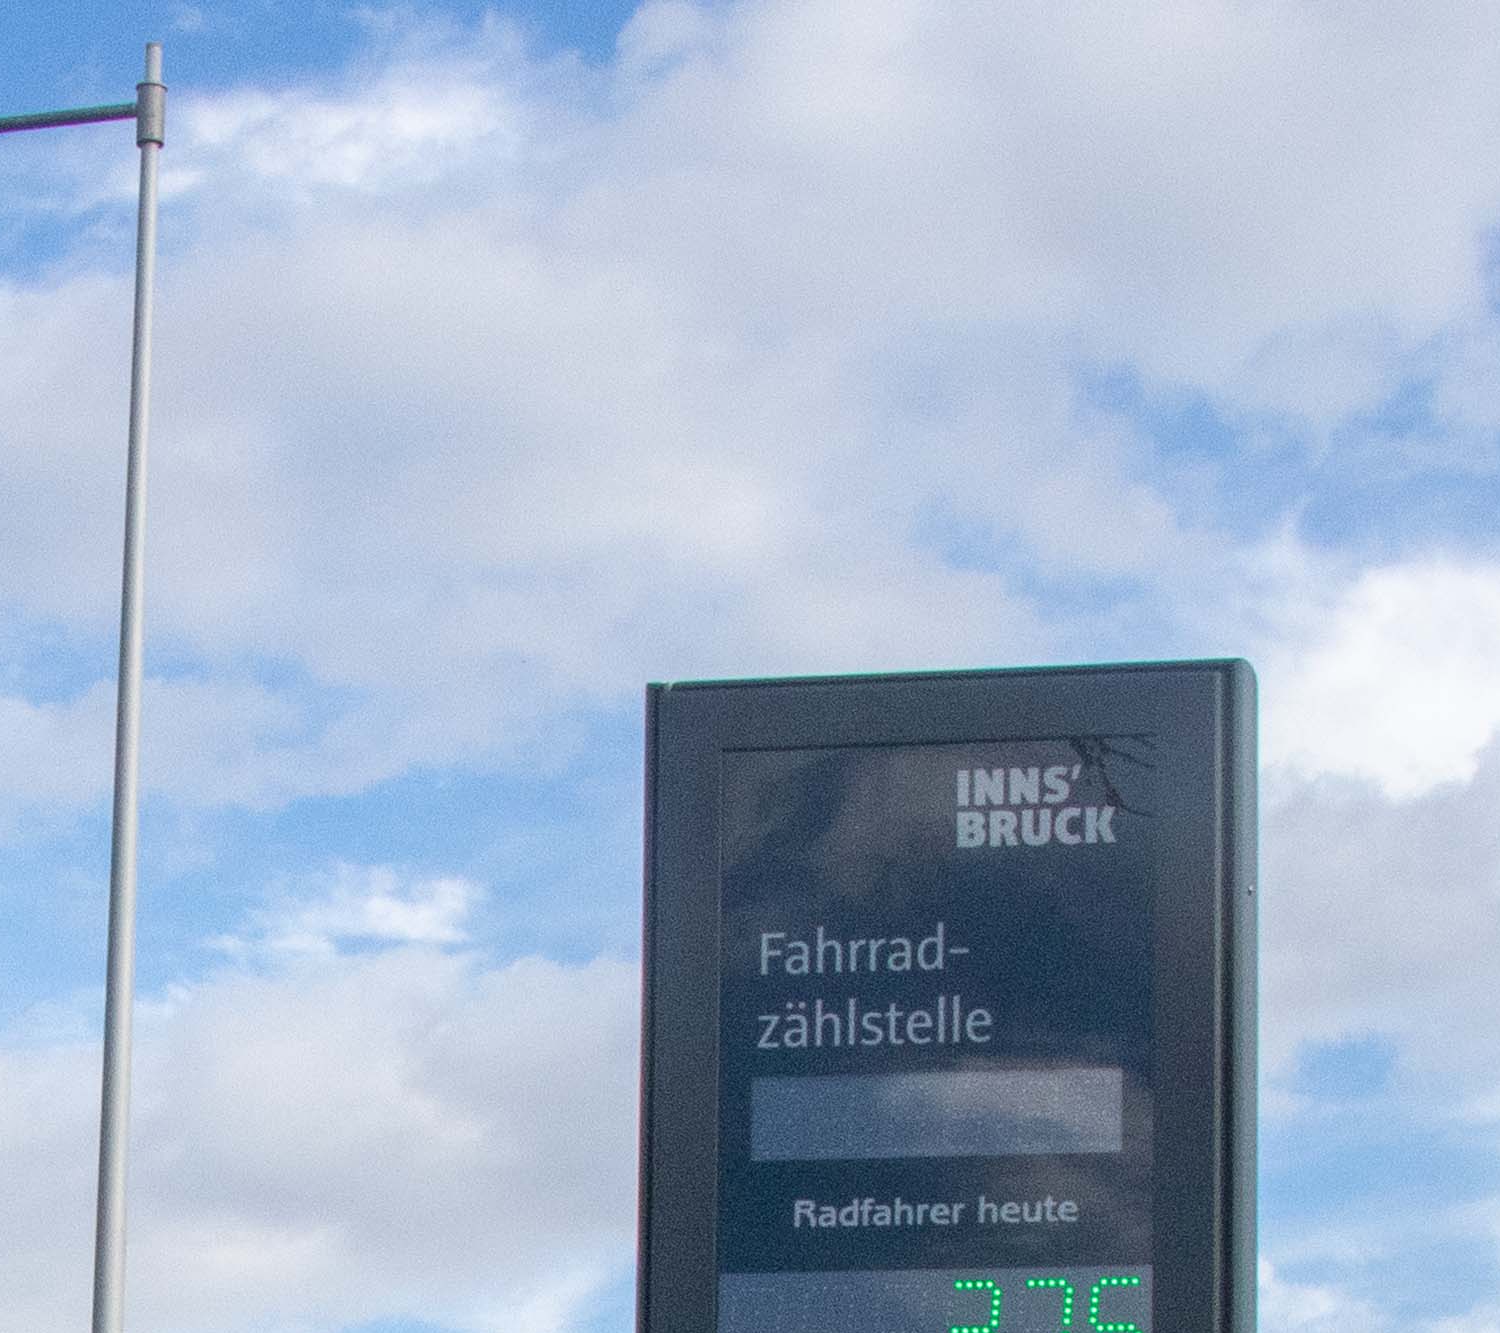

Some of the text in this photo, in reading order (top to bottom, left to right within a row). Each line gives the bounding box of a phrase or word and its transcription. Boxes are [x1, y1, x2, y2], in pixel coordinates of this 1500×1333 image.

[956, 806, 1117, 849] BRUCK
[758, 922, 971, 976] Fahrrad-
[757, 995, 994, 1049] zählstelle
[793, 1196, 1080, 1228] Radfahrer heute
